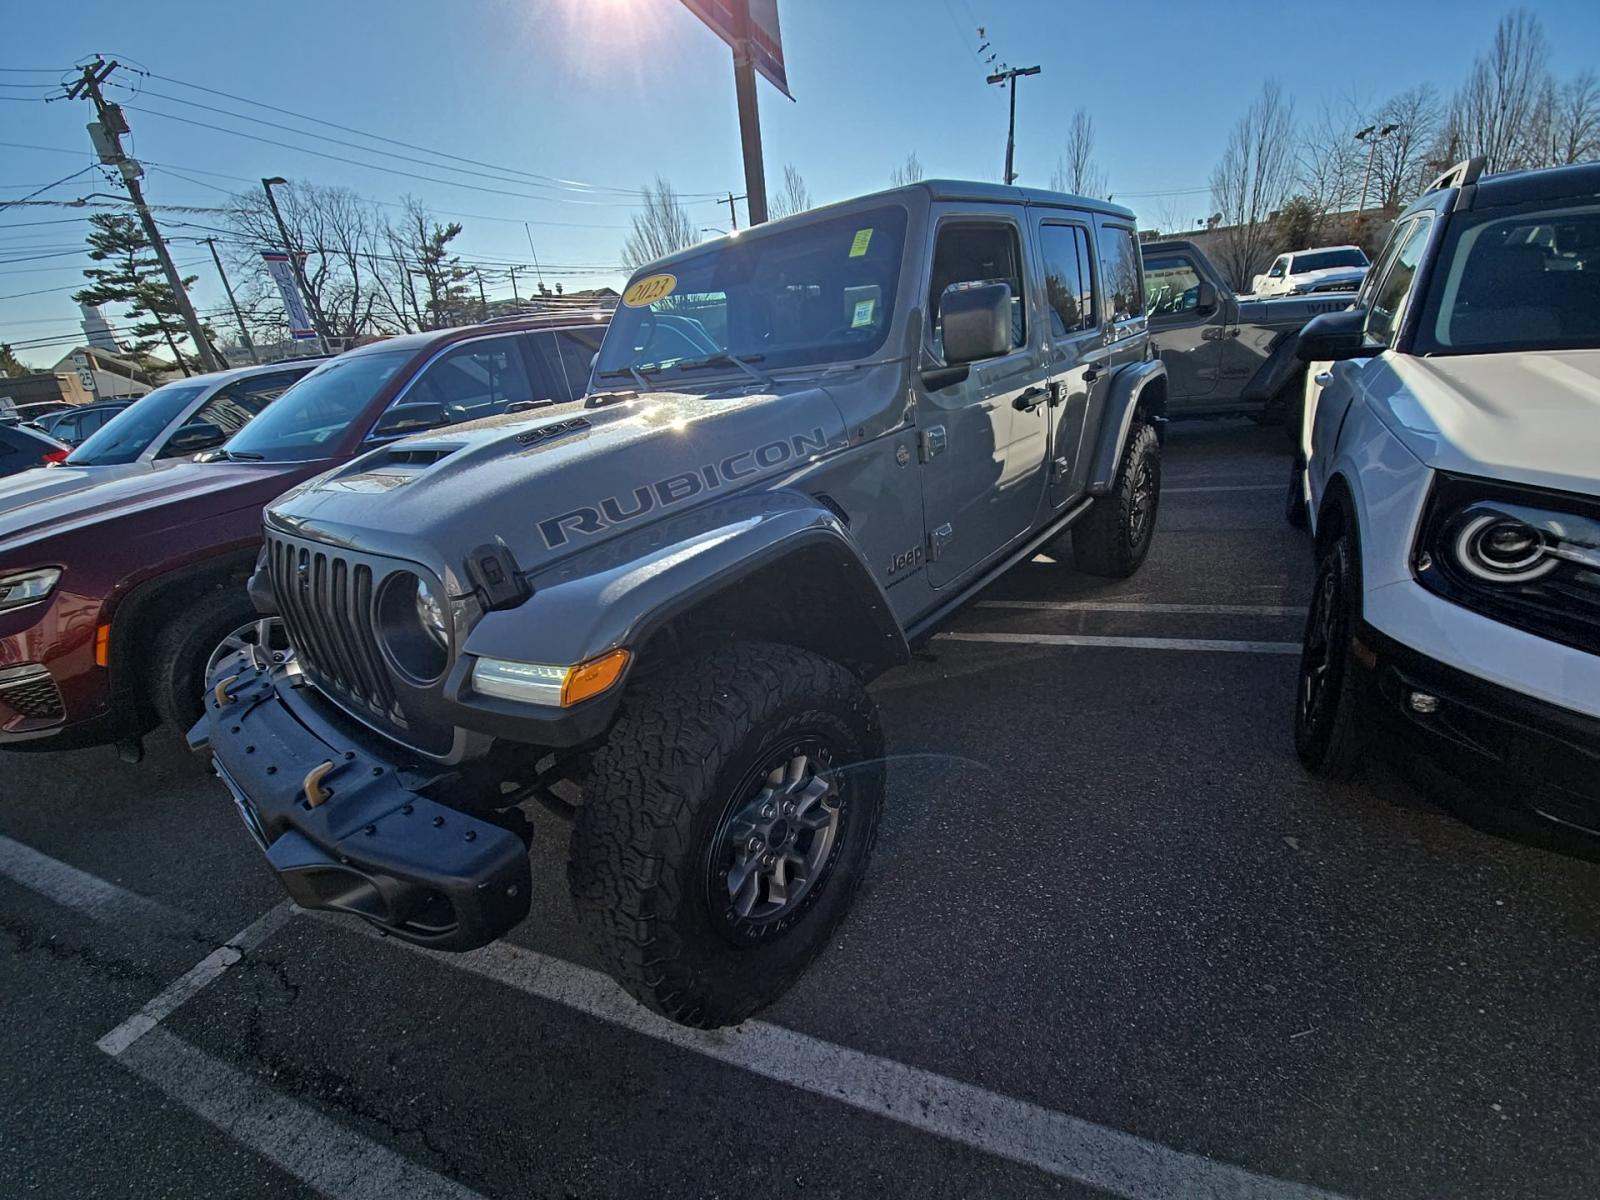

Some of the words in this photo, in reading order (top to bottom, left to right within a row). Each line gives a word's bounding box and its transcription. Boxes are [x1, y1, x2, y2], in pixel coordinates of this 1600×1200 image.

[626, 277, 670, 303] 2023
[80, 372, 93, 387] 25
[536, 426, 832, 549] RUBICON
[886, 545, 921, 575] Jeep
